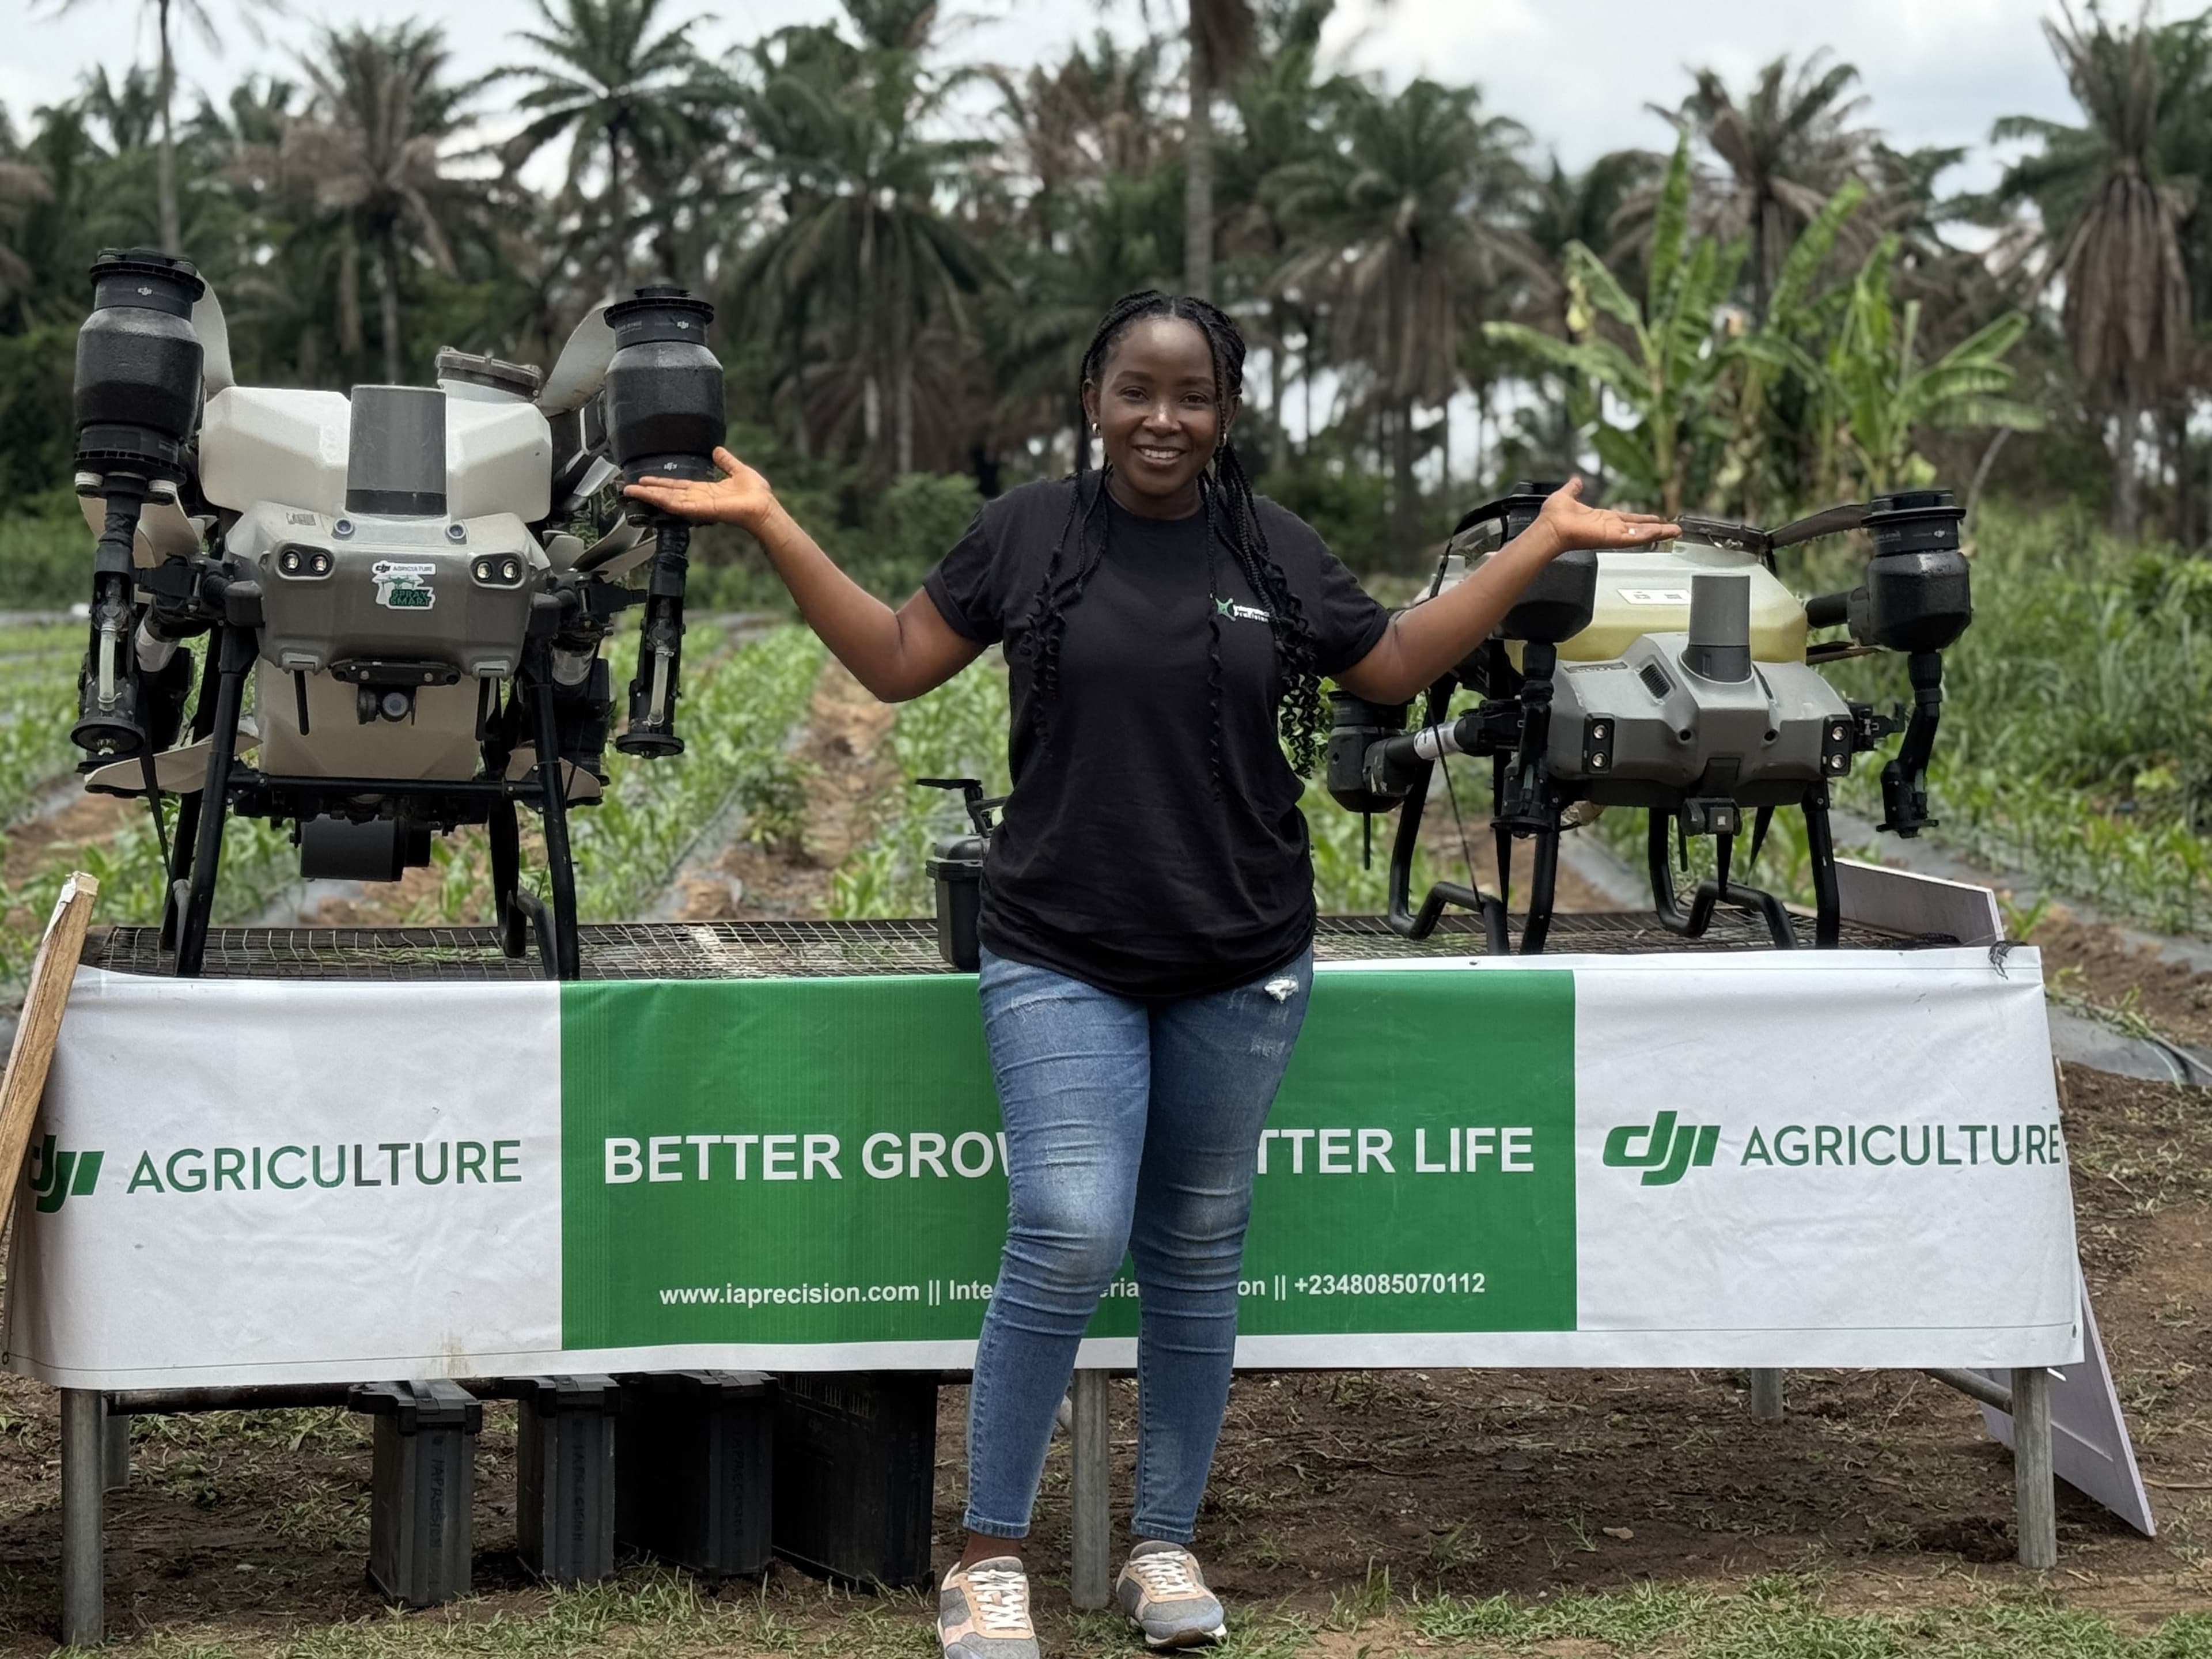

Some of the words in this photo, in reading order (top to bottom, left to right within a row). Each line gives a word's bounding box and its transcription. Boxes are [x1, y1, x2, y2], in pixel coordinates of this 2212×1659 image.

[391, 597, 431, 605] SMART
[393, 590, 429, 598] SPRAY
[604, 1134, 843, 1184] BETTER
[1257, 1128, 1396, 1174] TTER
[1415, 1127, 1535, 1173] LIFE
[1741, 1124, 2061, 1166] AGRICULTURE
[127, 1140, 522, 1194] AGRICULTURE
[660, 1280, 920, 1308] www.iaprecision.com
[949, 1279, 993, 1300] Inte
[1294, 1272, 1486, 1296] +2348085070112
